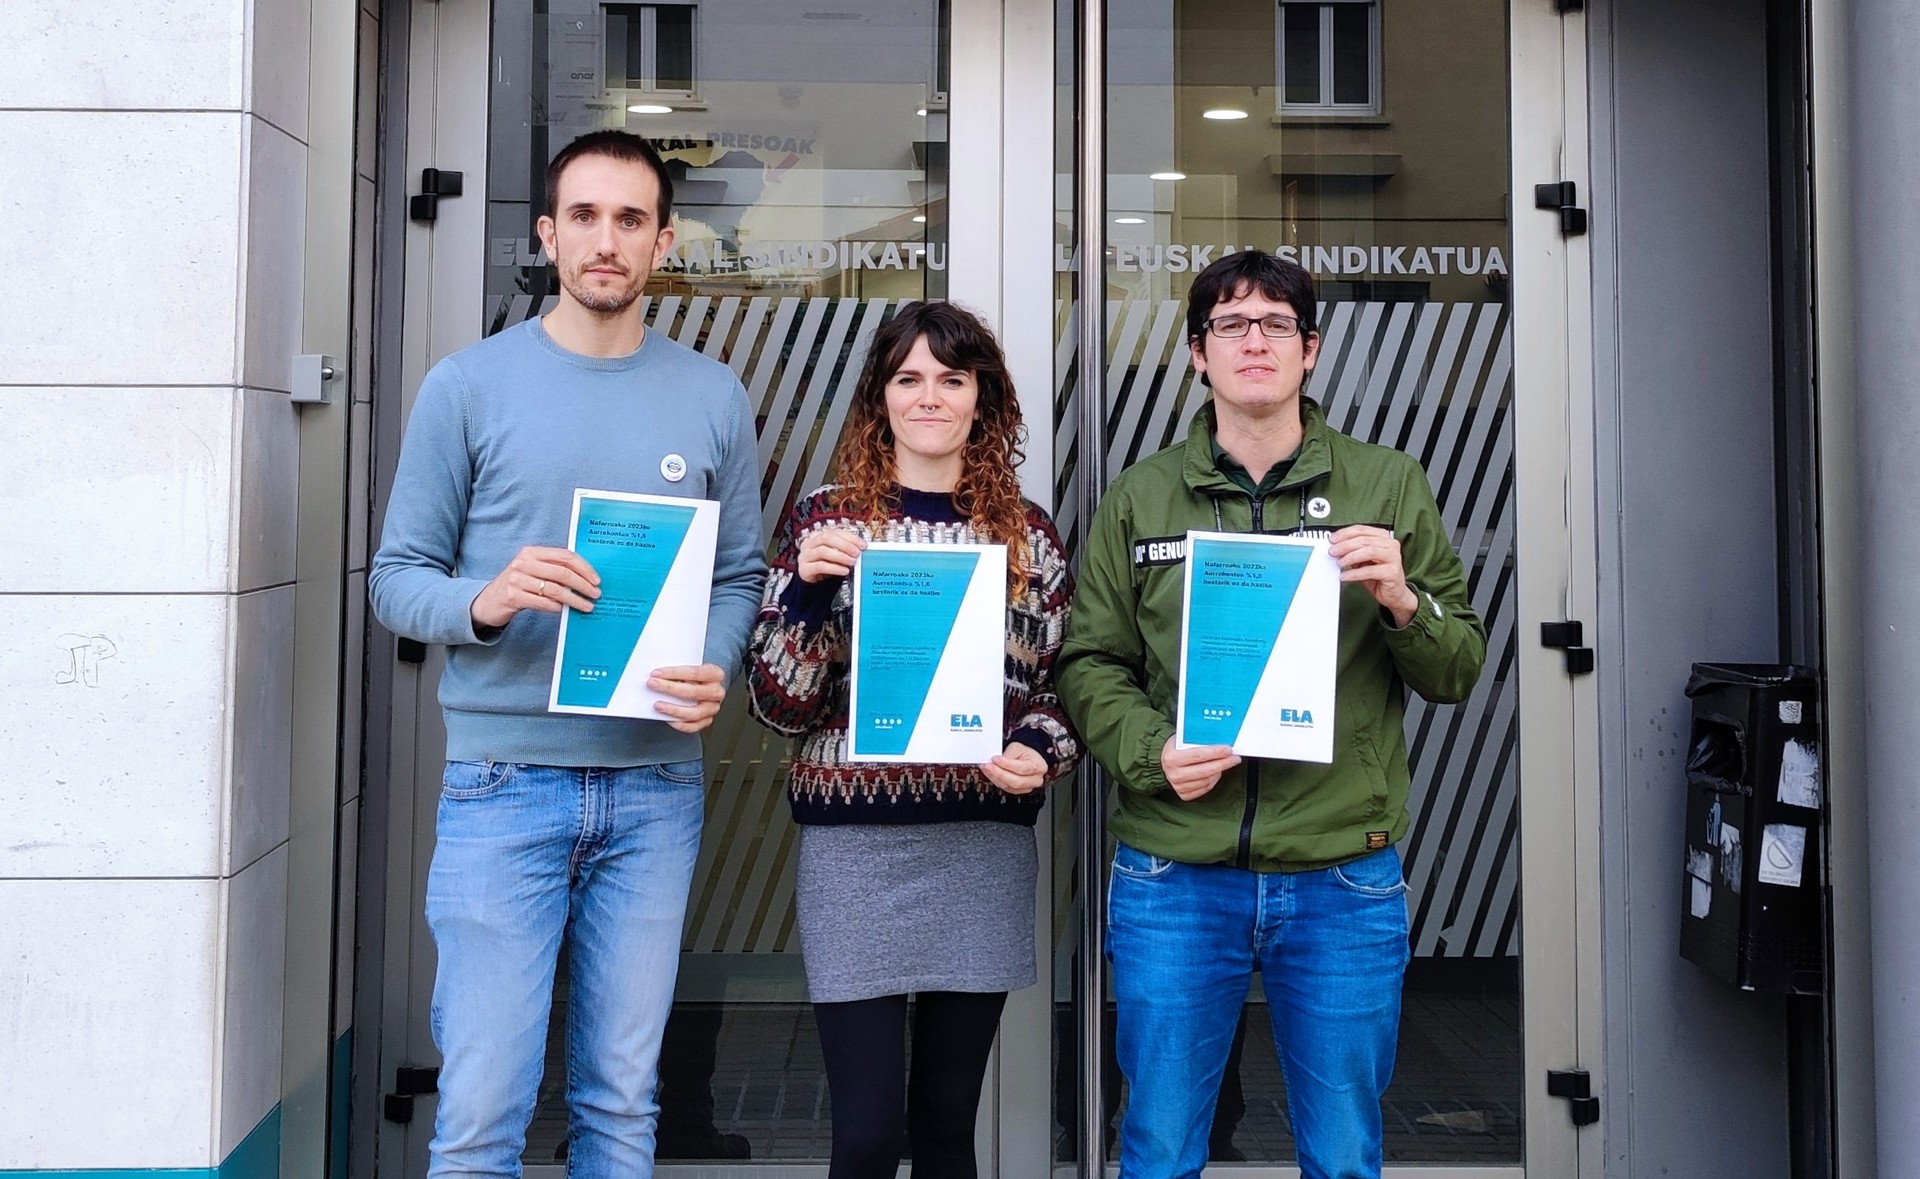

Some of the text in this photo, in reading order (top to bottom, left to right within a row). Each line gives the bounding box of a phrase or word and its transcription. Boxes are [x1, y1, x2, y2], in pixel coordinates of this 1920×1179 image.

[650, 132, 816, 154] KAL PRESOAK
[744, 240, 946, 271] SINDIKATU
[1275, 245, 1508, 275] SINDIKATUA
[950, 713, 983, 728] ELA
[1280, 708, 1314, 724] ELA
